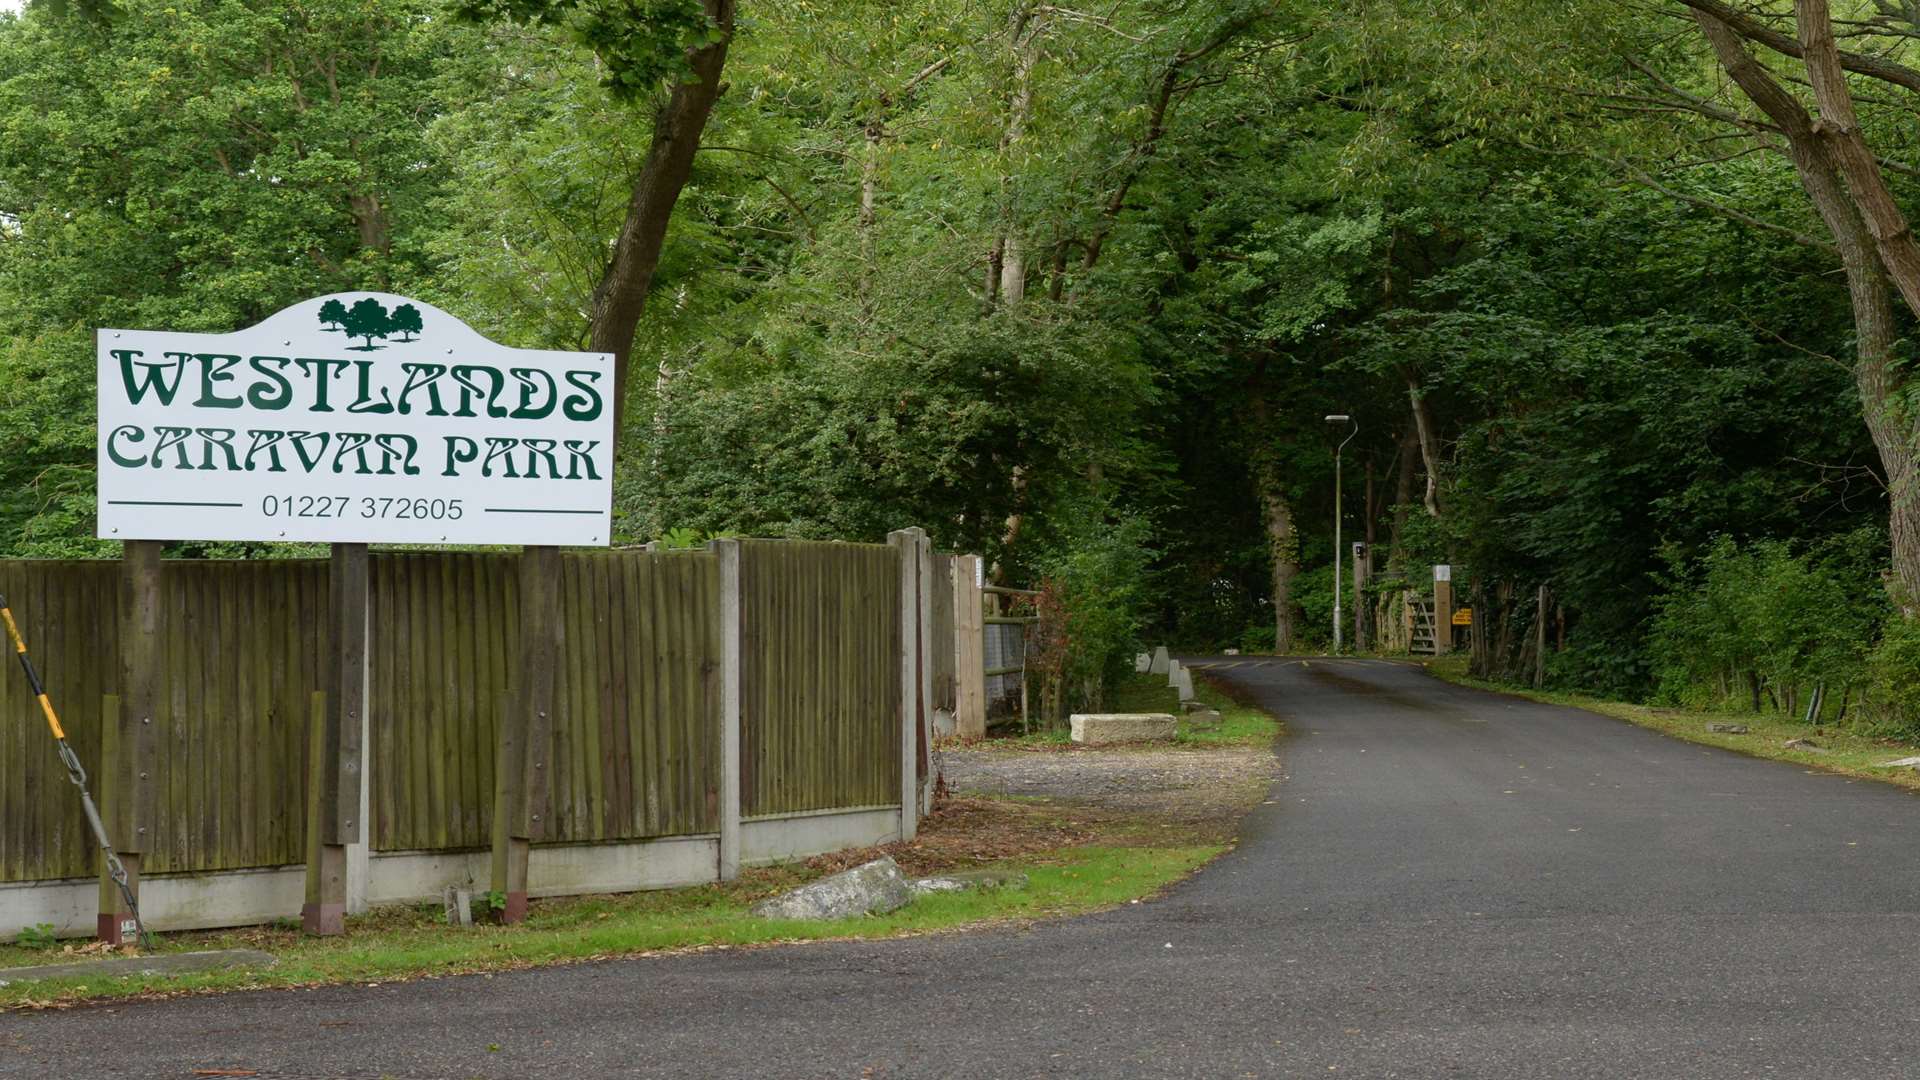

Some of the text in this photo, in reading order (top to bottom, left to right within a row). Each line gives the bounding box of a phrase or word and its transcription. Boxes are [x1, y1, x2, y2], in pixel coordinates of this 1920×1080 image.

[110, 349, 603, 421] WESTLANDS
[107, 425, 603, 481] CARAVAN PARK
[262, 495, 463, 520] 01227 372605
